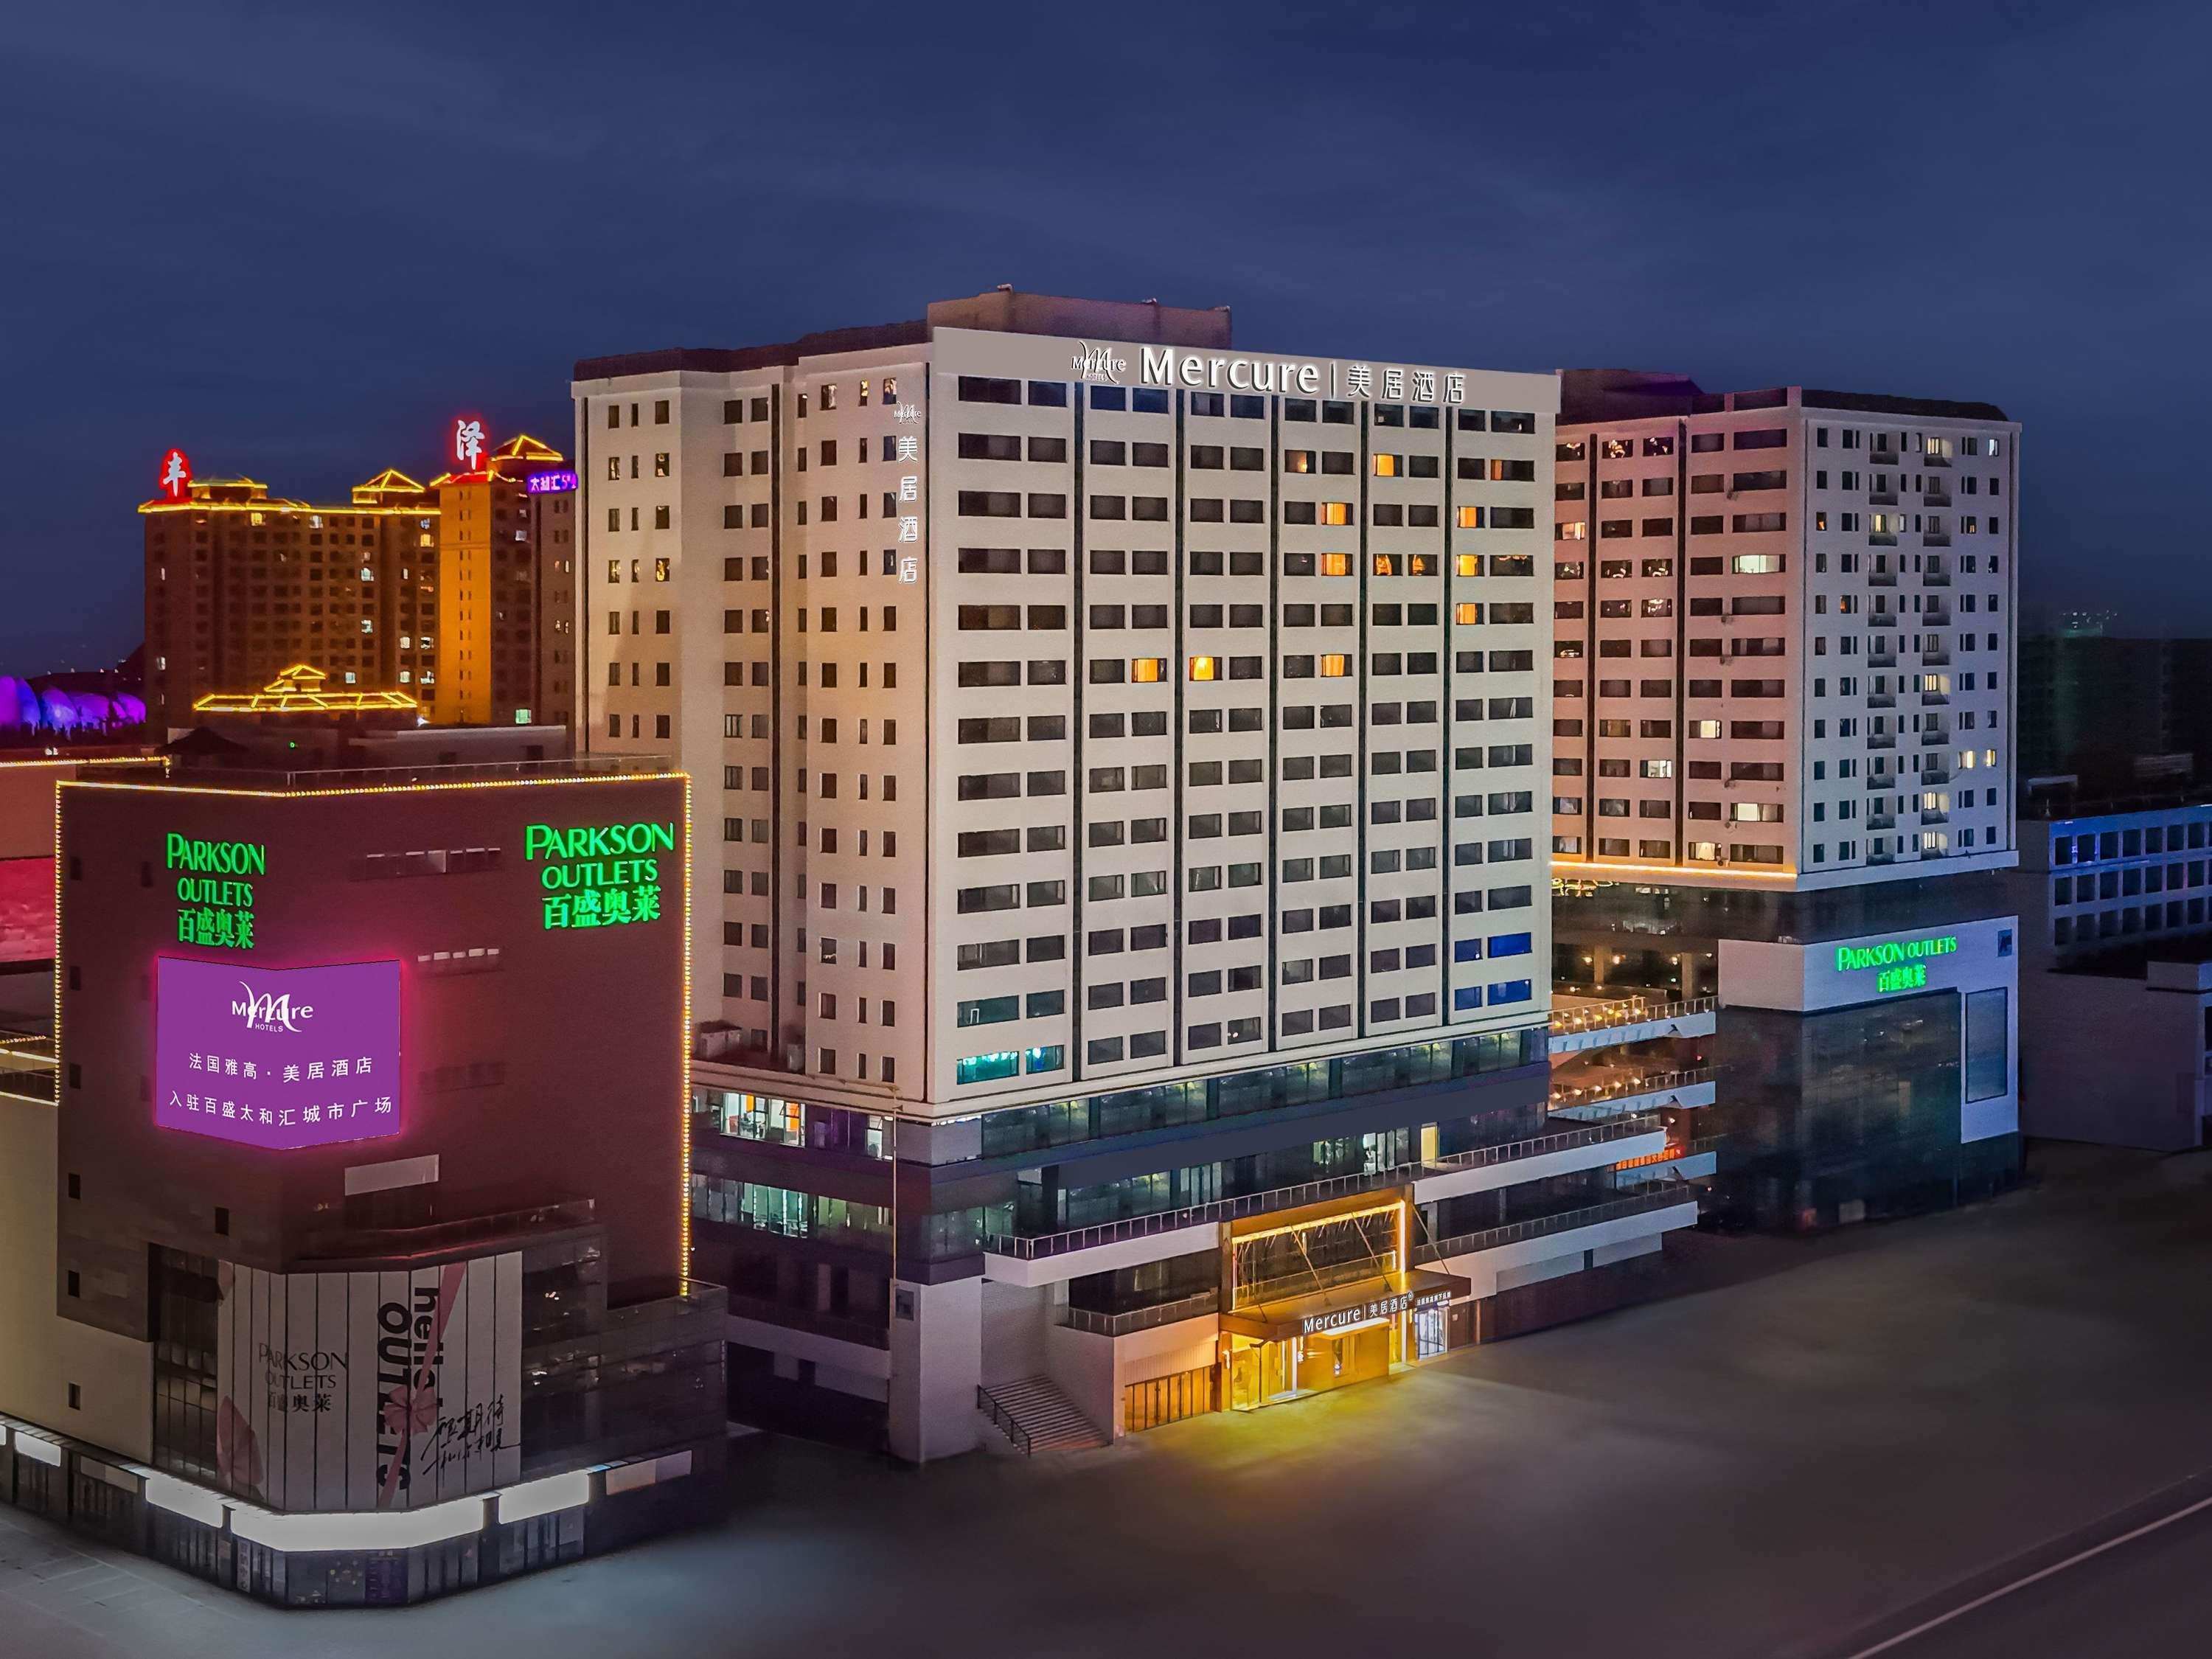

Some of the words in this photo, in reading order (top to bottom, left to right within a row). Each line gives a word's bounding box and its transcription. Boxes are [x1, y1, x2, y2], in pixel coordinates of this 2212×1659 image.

[1141, 346, 1319, 394] Mercure
[1346, 364, 1466, 404] 美居酒店
[897, 436, 918, 584] 美居酒店
[167, 832, 266, 876] PARKSON
[526, 822, 674, 861] PARKSON
[177, 877, 254, 908] OUTLETS
[542, 859, 658, 889] OUTLETS
[542, 885, 662, 930] 百盛奥莱
[177, 906, 255, 950] 百盛奥莱
[1837, 942, 1905, 972] PARKSON
[1907, 936, 1957, 959] OUTLETS
[255, 1023, 284, 1033] HOTELS
[169, 1090, 392, 1127] 入驻百盛太和汇城市广场
[1302, 1308, 1361, 1334] Mercure
[259, 1342, 349, 1371] PARKSON
[413, 1287, 444, 1408] hello
[265, 1370, 336, 1390] OUTLETS
